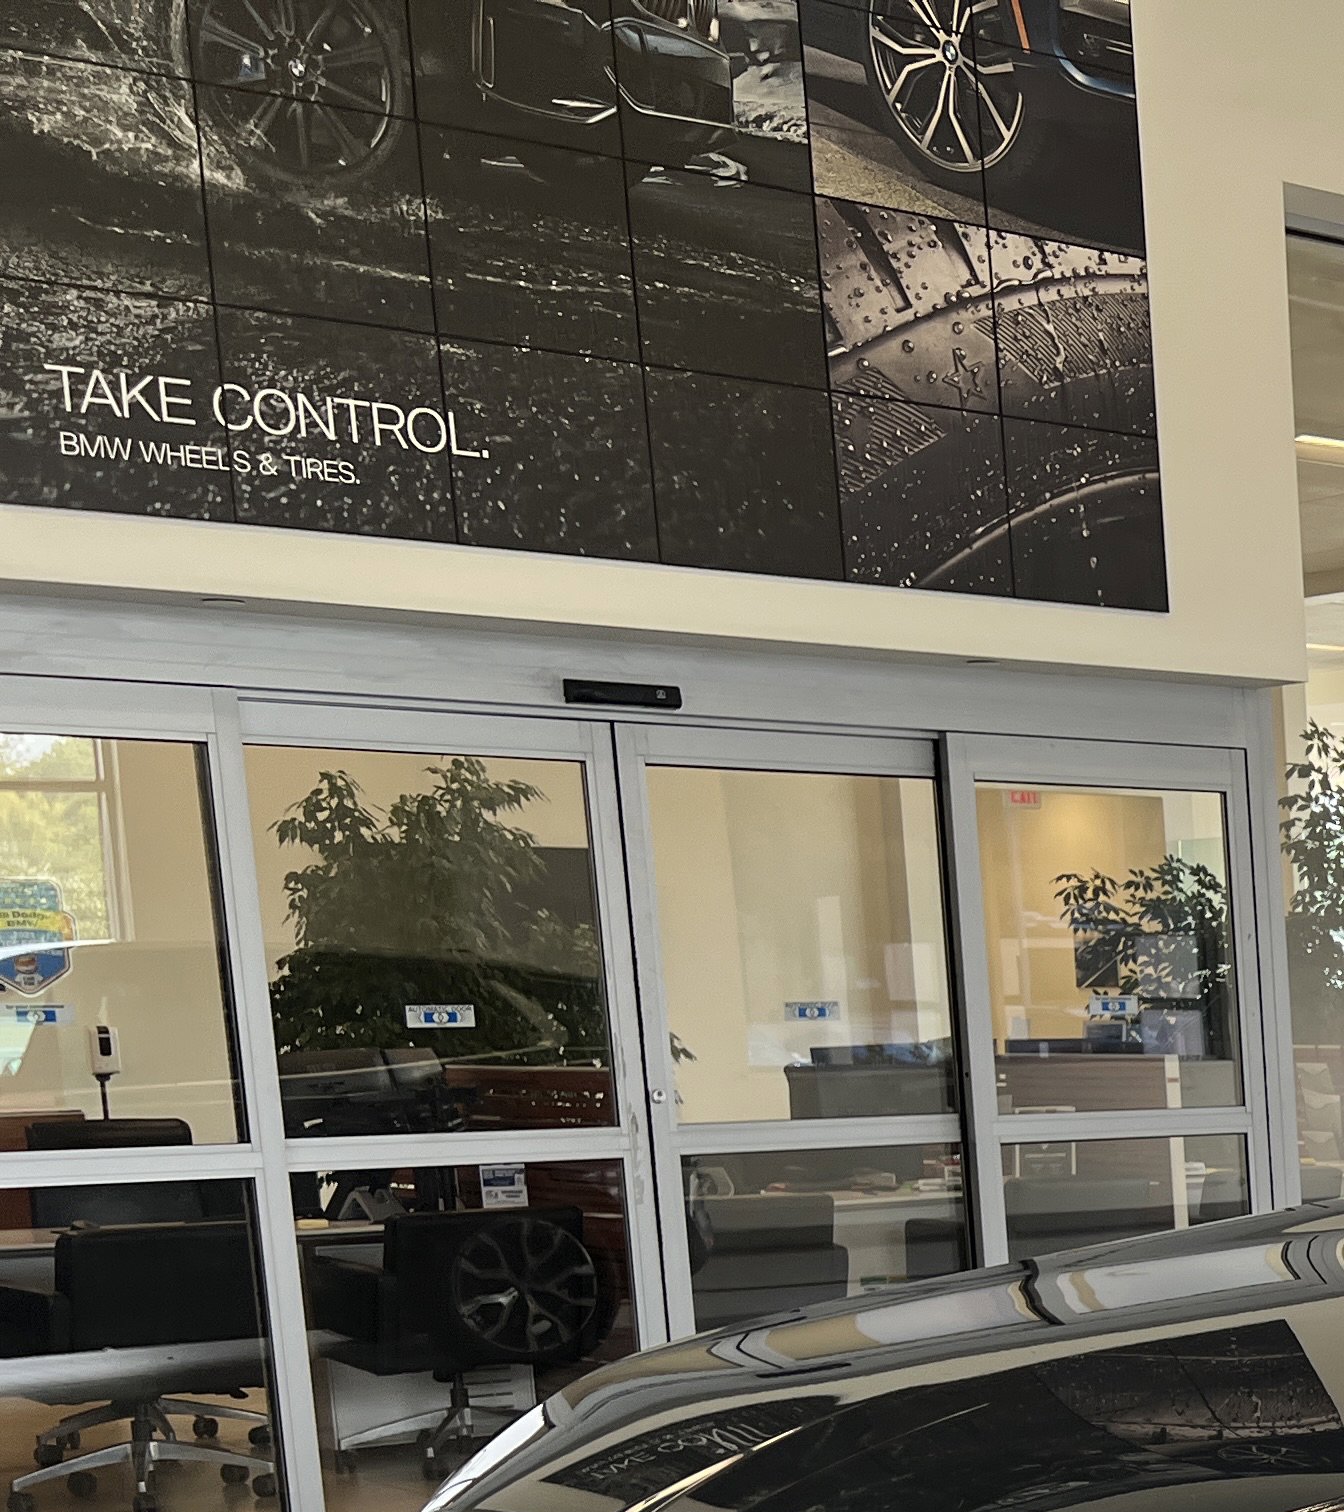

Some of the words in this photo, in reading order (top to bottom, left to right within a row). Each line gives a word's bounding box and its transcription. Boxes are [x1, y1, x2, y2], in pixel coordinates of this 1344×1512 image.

[43, 363, 196, 427] TAKE
[212, 383, 490, 459] CONTROL.
[59, 431, 132, 461] BMW
[141, 442, 252, 474] WHEELS
[258, 455, 279, 477] &
[284, 456, 361, 485] TIRES.
